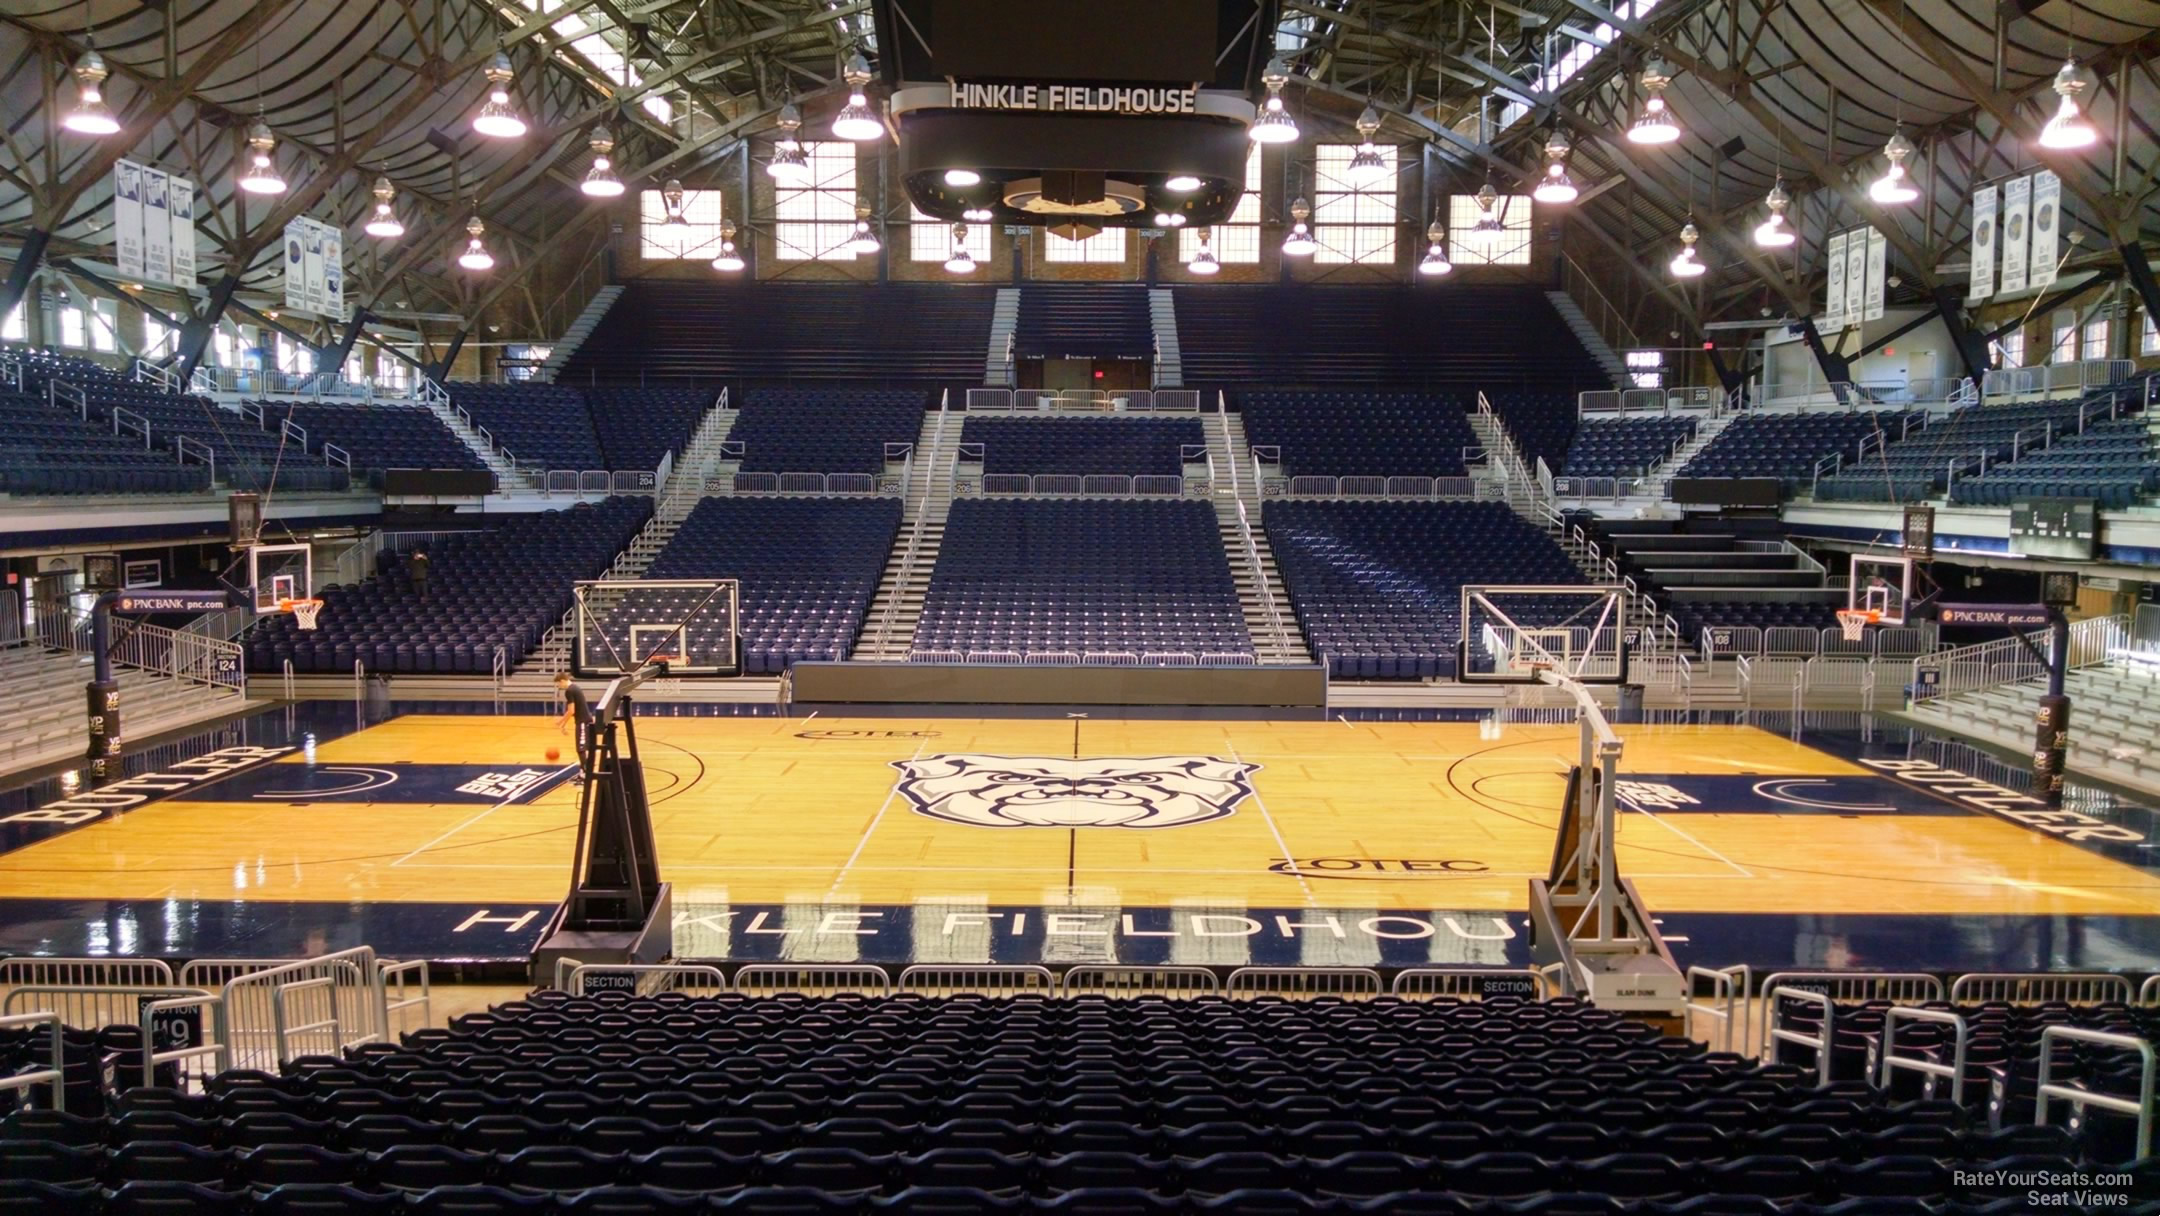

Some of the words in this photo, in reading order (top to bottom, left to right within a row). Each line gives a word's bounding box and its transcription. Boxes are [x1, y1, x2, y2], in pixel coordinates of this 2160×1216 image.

[951, 83, 1037, 109] HINKLE
[1049, 86, 1195, 113] FIELDHOUSE
[639, 478, 653, 486] 204
[884, 484, 900, 493] 205
[1265, 487, 1280, 495] 207
[187, 601, 224, 611] pnc.com
[2007, 615, 2046, 625] pnc.com
[1715, 635, 1729, 645] 108
[219, 660, 236, 671] 124
[0, 746, 296, 824] BUTLER
[454, 772, 510, 794] BIG
[480, 768, 546, 798] EAST
[1858, 758, 2146, 841] BUTLER
[452, 910, 884, 935] HKLE
[584, 976, 634, 988] SECTION
[1484, 981, 1533, 993] SECTION
[1616, 989, 1636, 997] SLAM
[1637, 989, 1656, 997] DUNK
